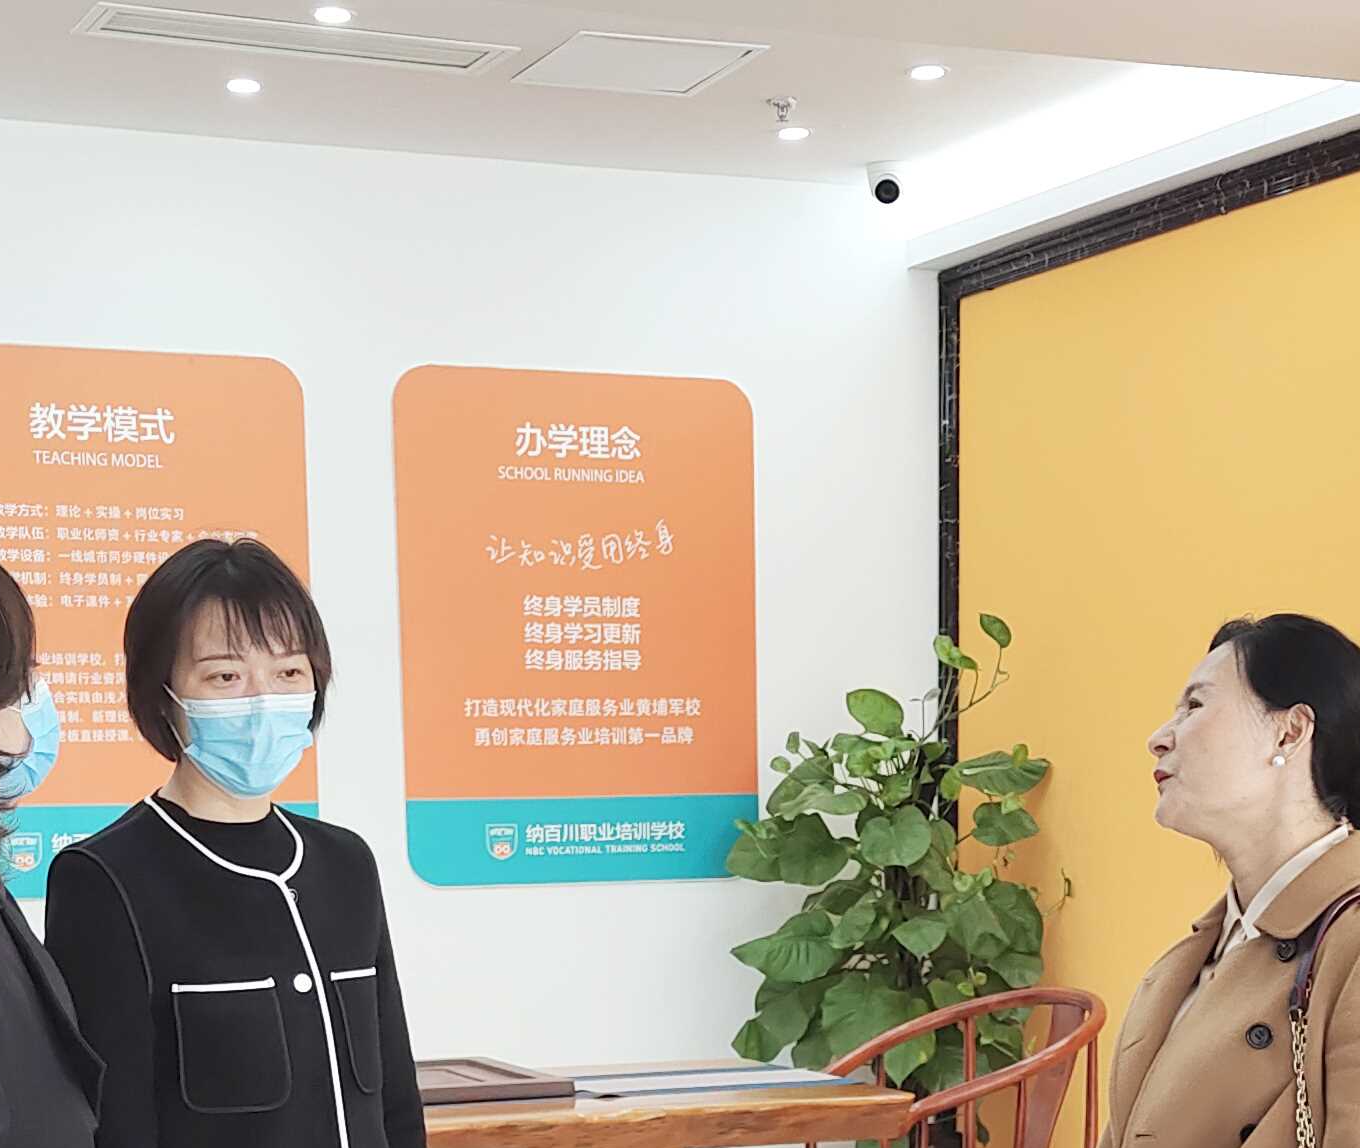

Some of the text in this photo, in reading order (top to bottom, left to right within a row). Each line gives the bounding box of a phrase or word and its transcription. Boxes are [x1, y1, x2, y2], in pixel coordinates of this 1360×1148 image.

[29, 402, 176, 444] 教学模式
[515, 422, 641, 460] 办学理念
[33, 450, 164, 469] TEACHING MODEL
[497, 465, 645, 484] SCHOOL RUNNING IDEA
[485, 519, 675, 570] 让知识受用终身
[523, 595, 641, 618] 终身学员制度
[524, 622, 641, 645] 终身学习更新
[525, 649, 642, 671] 终身服务指导
[464, 698, 702, 718] 打造现代化家庭服务业黄埔军校
[474, 726, 695, 746] 勇创家庭服务业培训第一品牌
[525, 821, 685, 844] 纳百川职业培训学校
[547, 844, 602, 855] VOCATIONAL
[606, 843, 648, 853] TRAINING
[650, 842, 685, 852] SCHOOL
